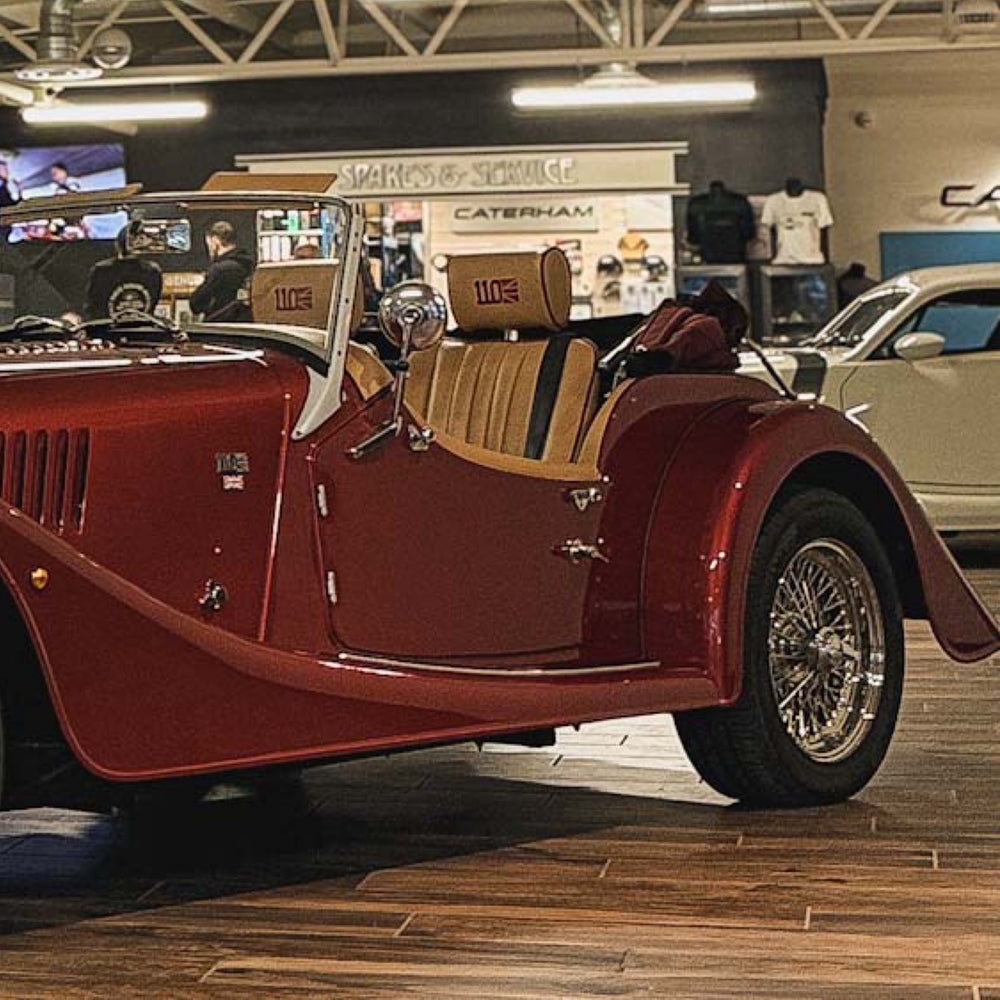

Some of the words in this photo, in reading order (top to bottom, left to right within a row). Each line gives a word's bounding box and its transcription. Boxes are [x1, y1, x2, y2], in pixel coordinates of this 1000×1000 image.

[340, 162, 436, 190] SPARES
[472, 158, 577, 187] SERVICE
[454, 206, 593, 220] CATERHAM
